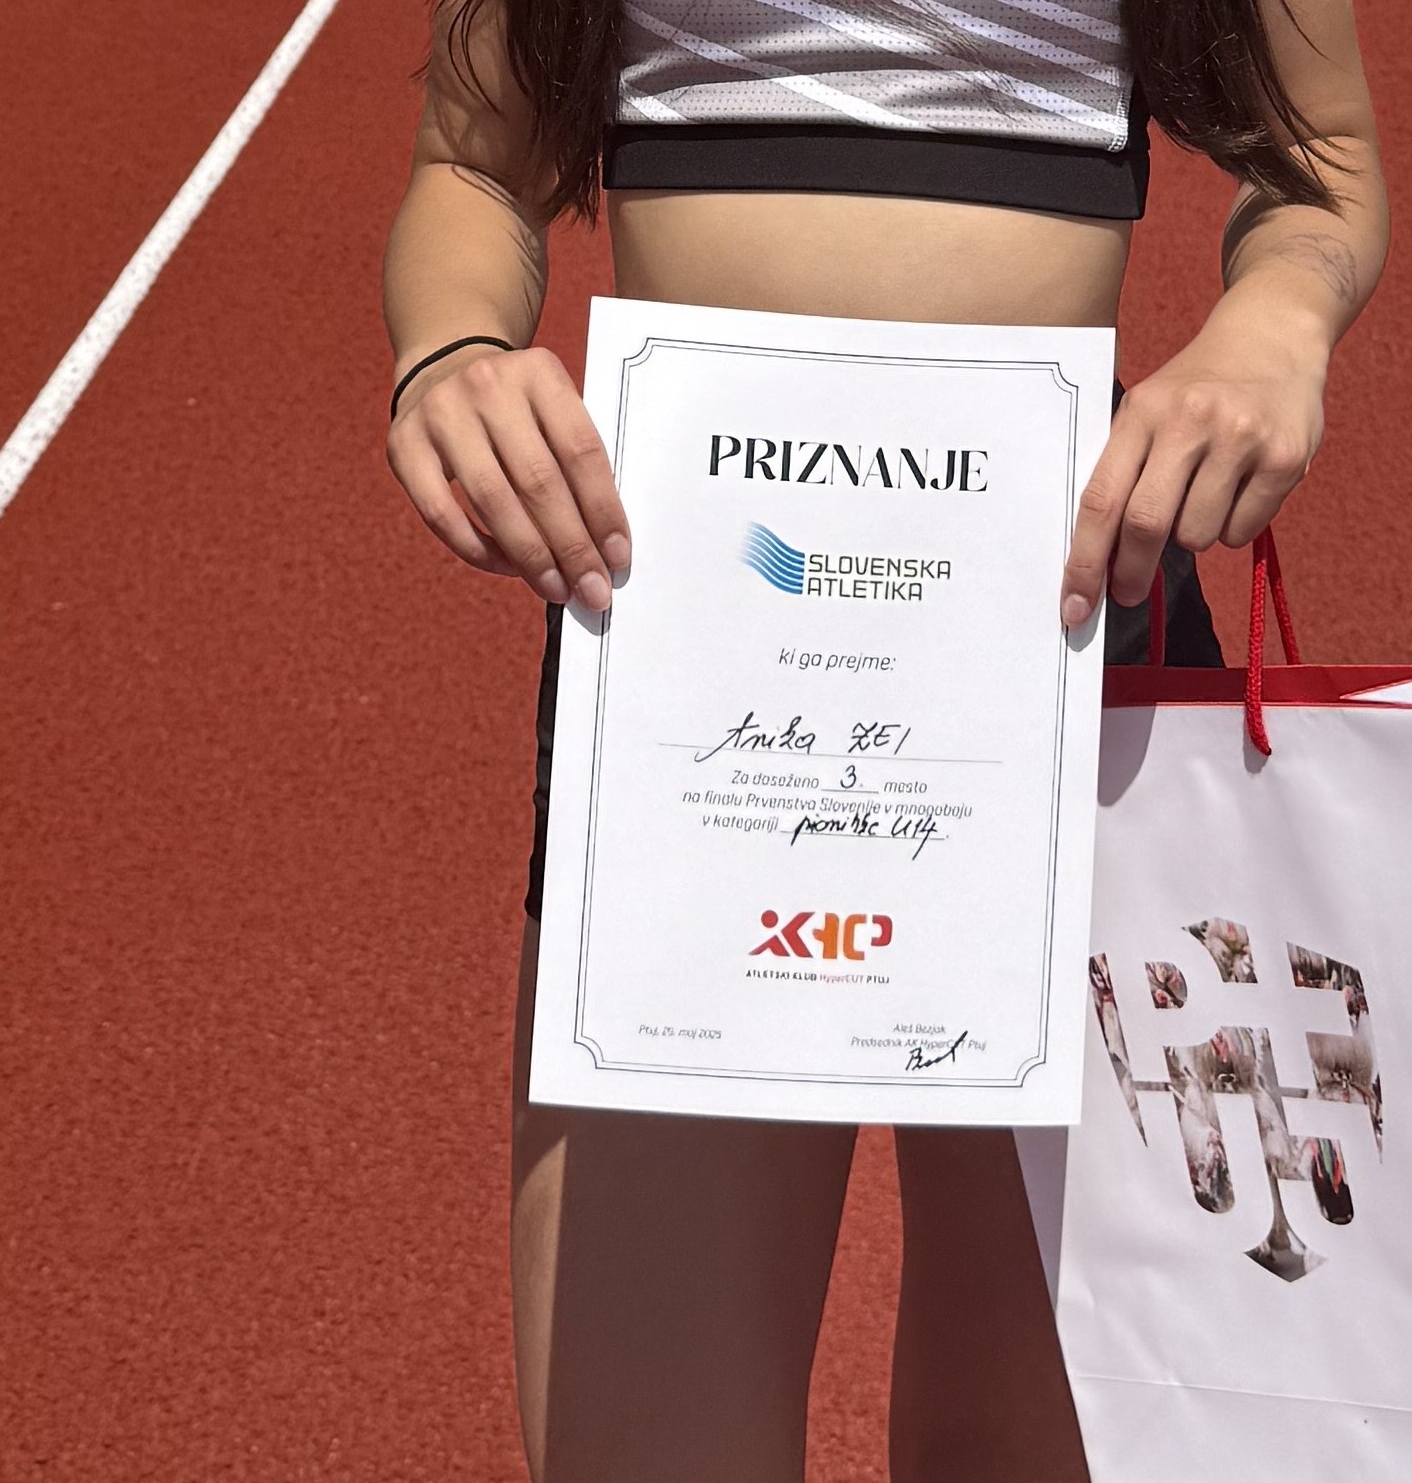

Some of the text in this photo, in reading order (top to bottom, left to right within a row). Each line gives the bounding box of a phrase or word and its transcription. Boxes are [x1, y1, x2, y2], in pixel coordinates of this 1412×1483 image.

[708, 434, 989, 492] PRIZNANJE
[808, 553, 952, 581] SLOVENSKA
[807, 577, 923, 602] ATLETIKA
[778, 648, 897, 673] ki ga prejme:
[732, 770, 749, 785] Za
[682, 792, 701, 804] na
[704, 790, 743, 806] finalu
[746, 796, 817, 811] Prvenstva
